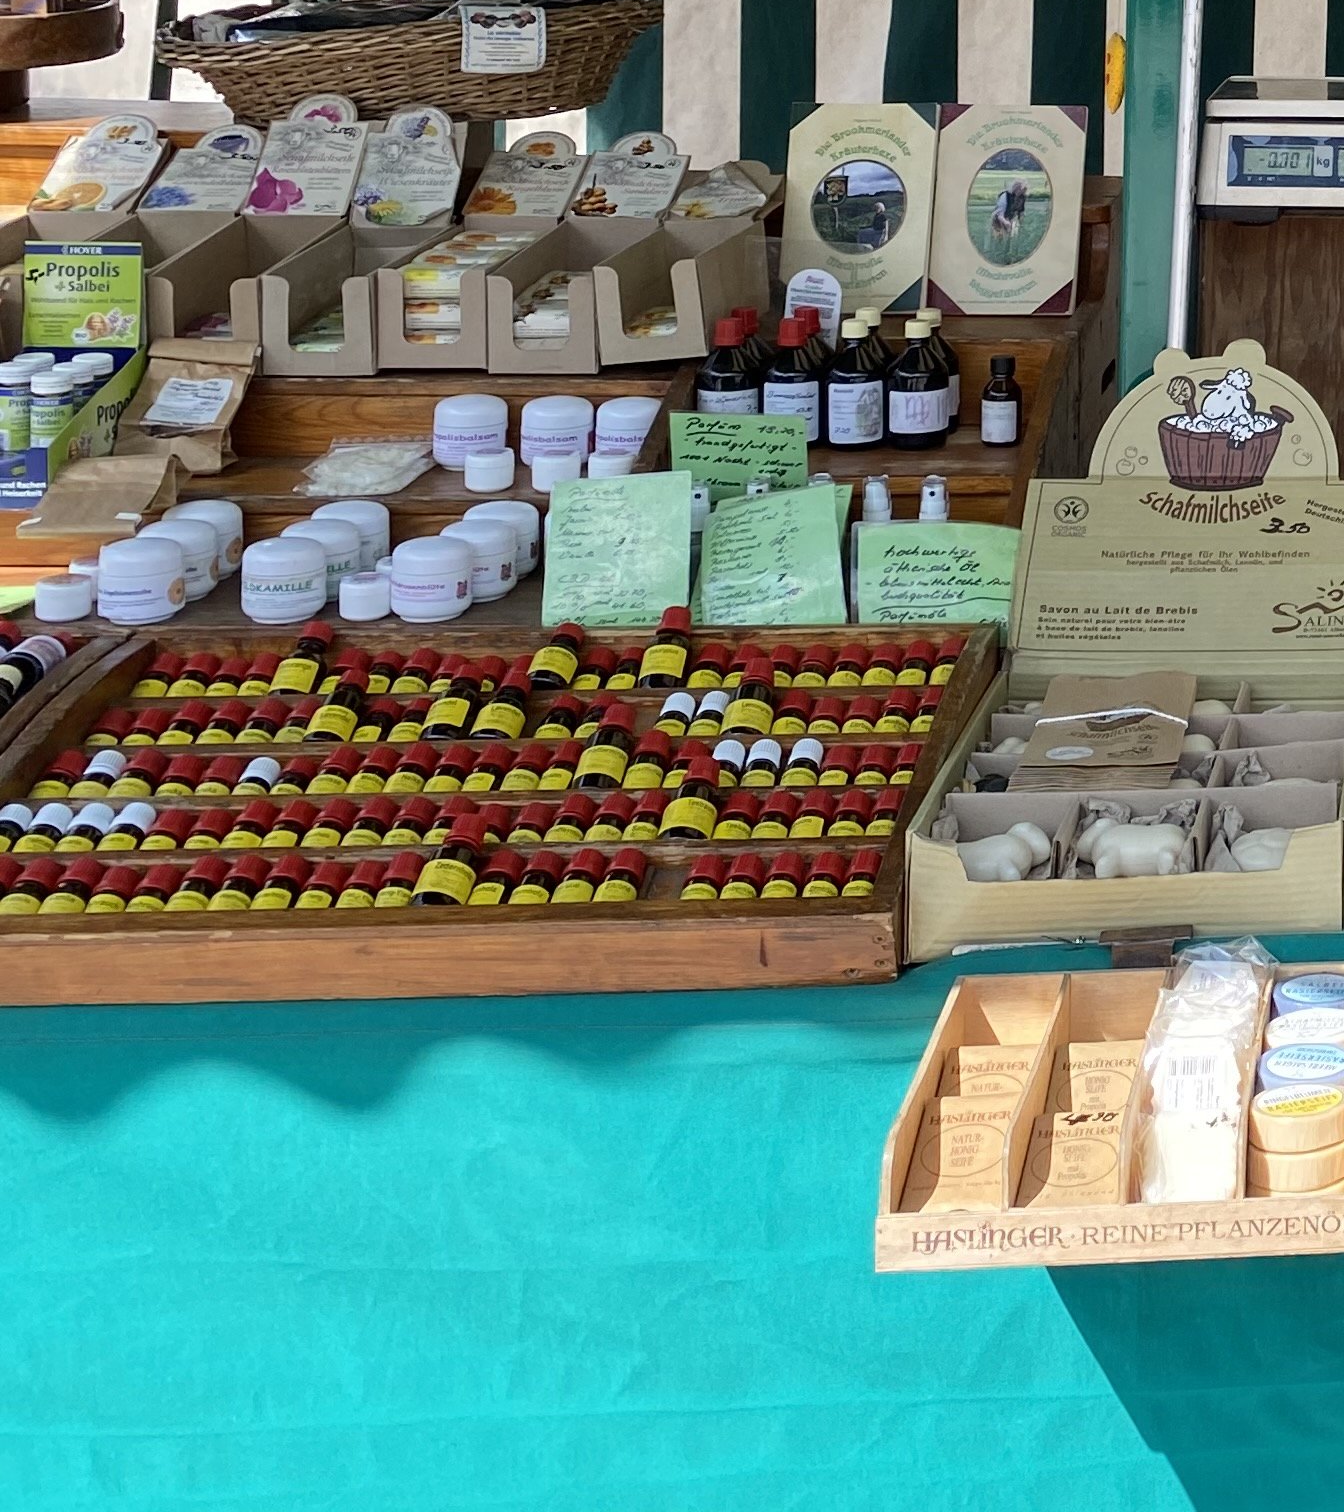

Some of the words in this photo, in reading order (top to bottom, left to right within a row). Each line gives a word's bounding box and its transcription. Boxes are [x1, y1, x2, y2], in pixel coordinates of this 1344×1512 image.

[1316, 156, 1330, 168] kg
[46, 261, 120, 281] Propolis
[68, 280, 110, 292] Salbei
[1138, 490, 1288, 525] Schafmilchseife
[1051, 524, 1087, 532] COSMOS
[1101, 549, 1155, 559] Natürliche
[1161, 549, 1193, 560] Pflege
[1198, 549, 1214, 559] für
[1218, 550, 1233, 559] Ihr
[1238, 549, 1310, 559] Wohlbefinden
[1039, 604, 1079, 615] Savon
[1084, 606, 1100, 615] au
[1105, 605, 1130, 615] Lait
[1135, 605, 1151, 615] de
[1156, 605, 1199, 615] Brebis
[1079, 1225, 1168, 1247] REINE
